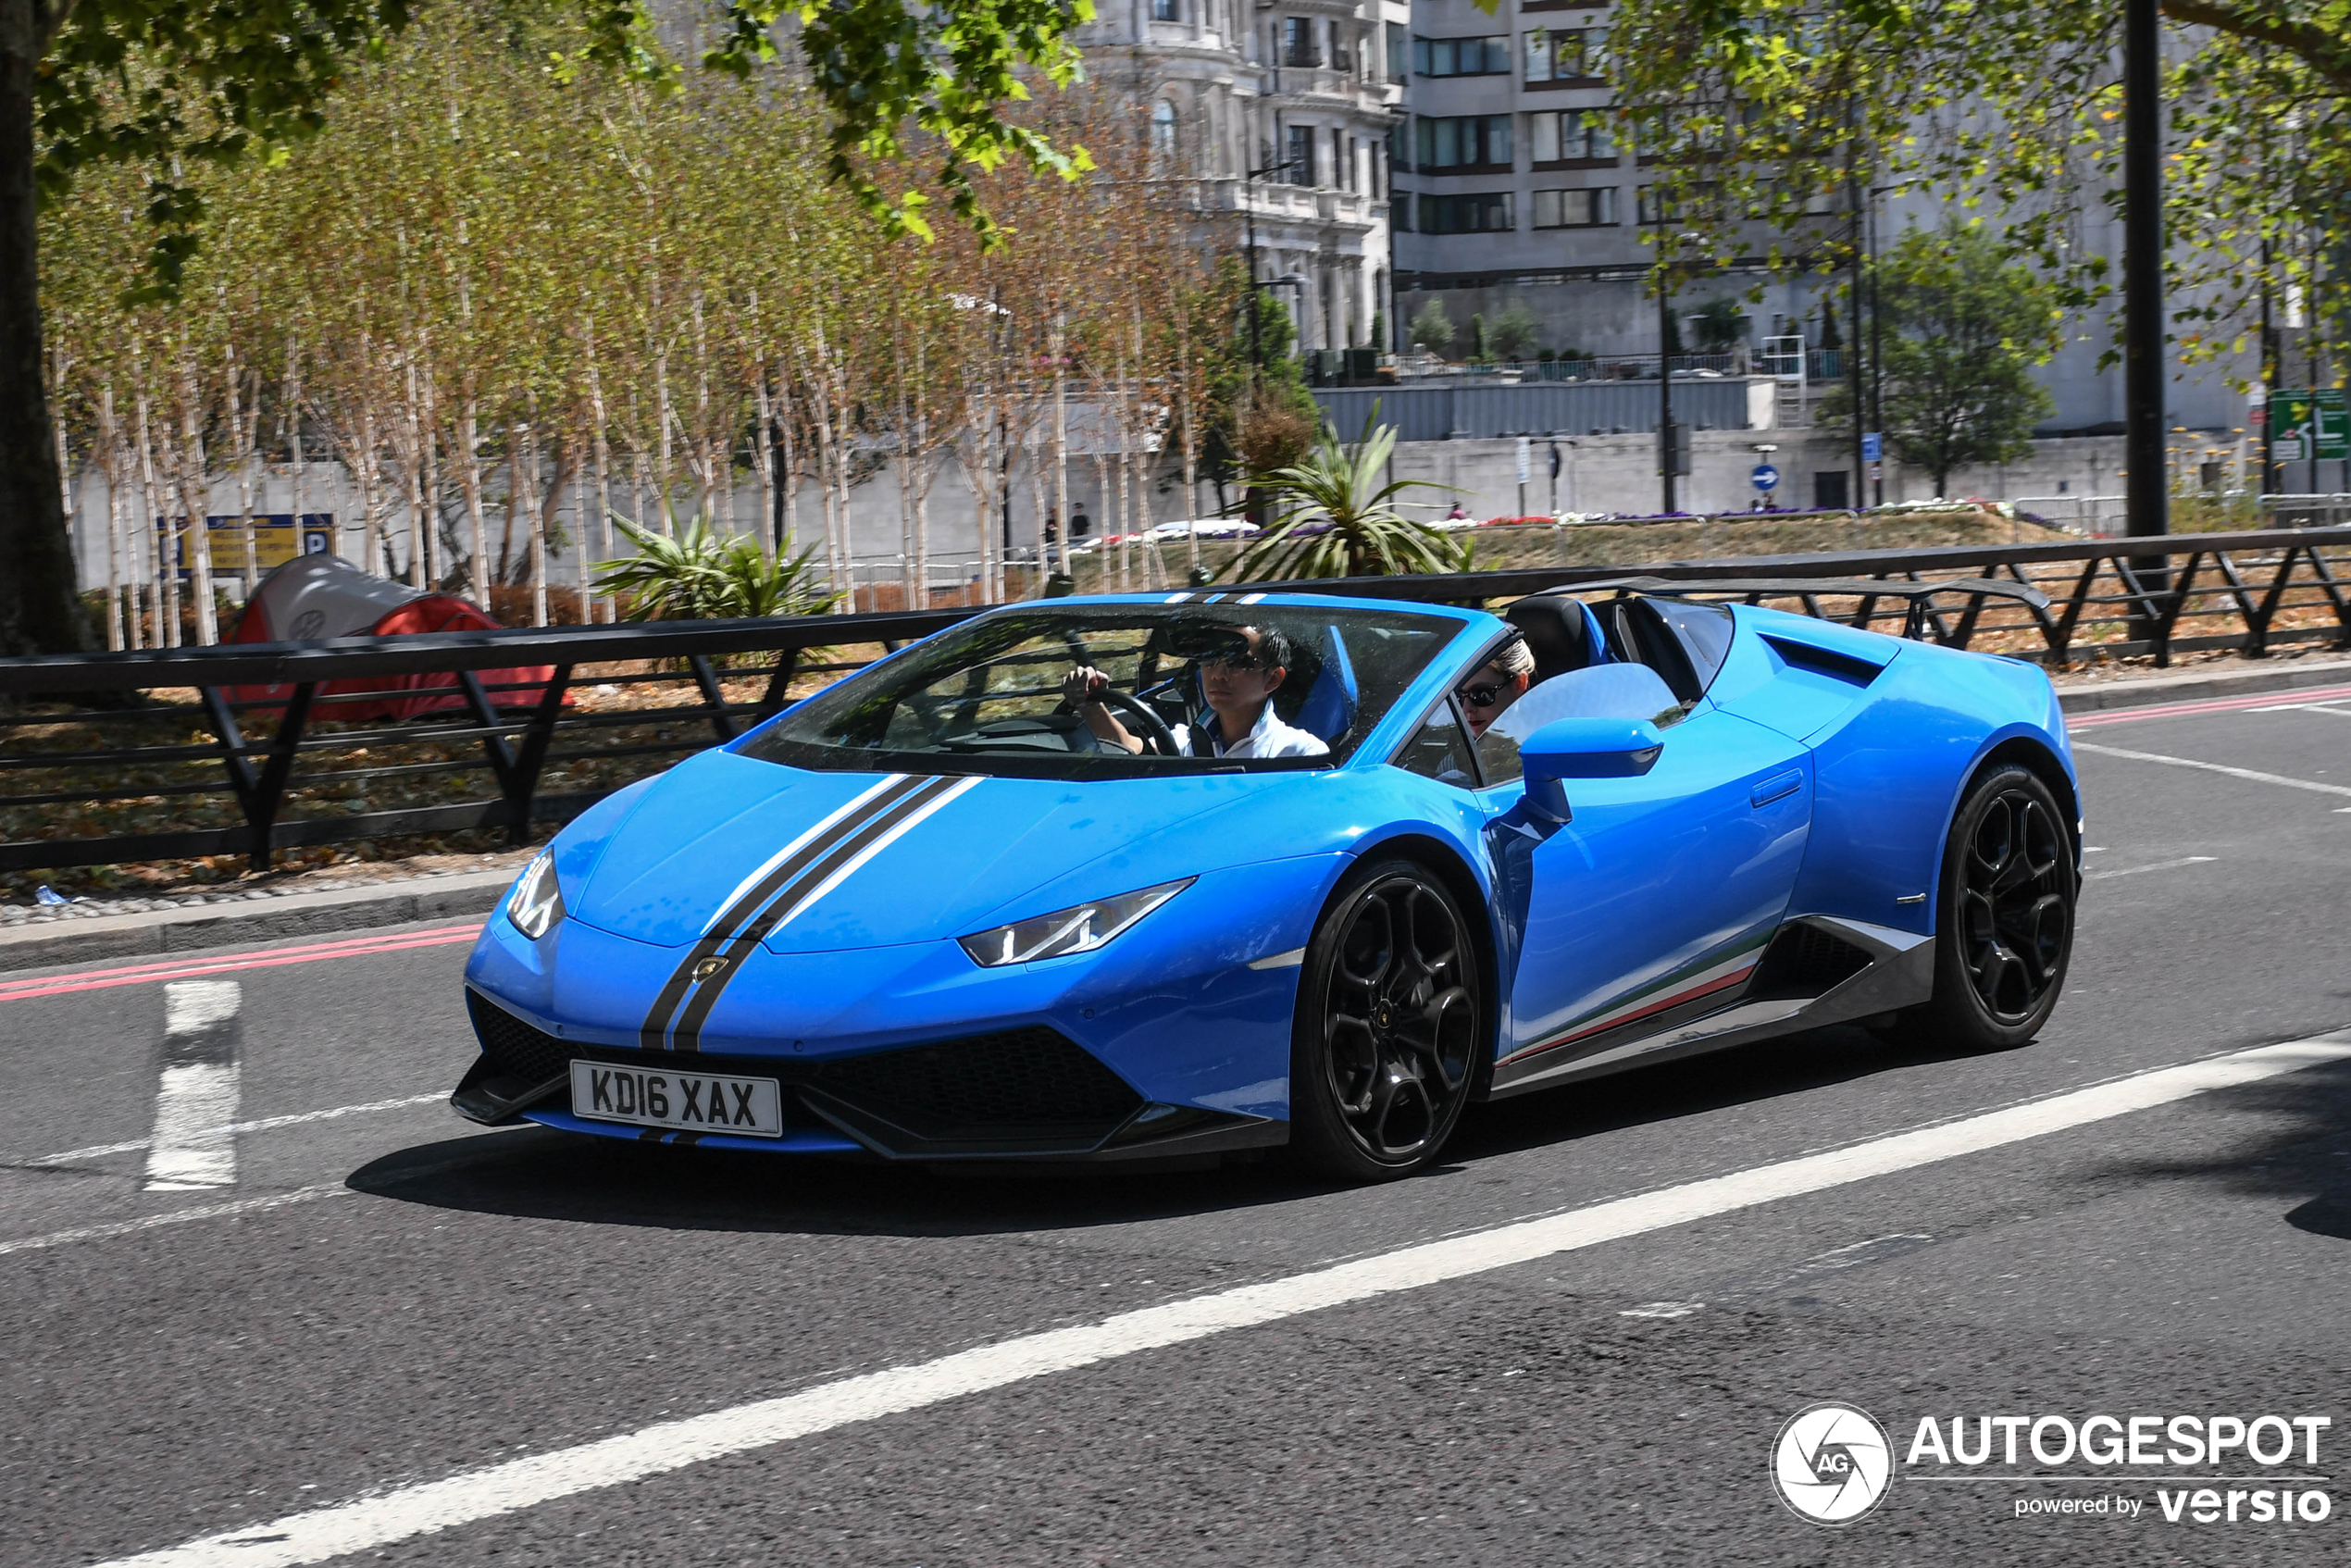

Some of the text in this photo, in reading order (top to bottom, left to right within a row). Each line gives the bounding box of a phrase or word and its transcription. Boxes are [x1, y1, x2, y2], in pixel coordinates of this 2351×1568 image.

[306, 534, 326, 555] P
[591, 1068, 756, 1127] KD16 XAX
